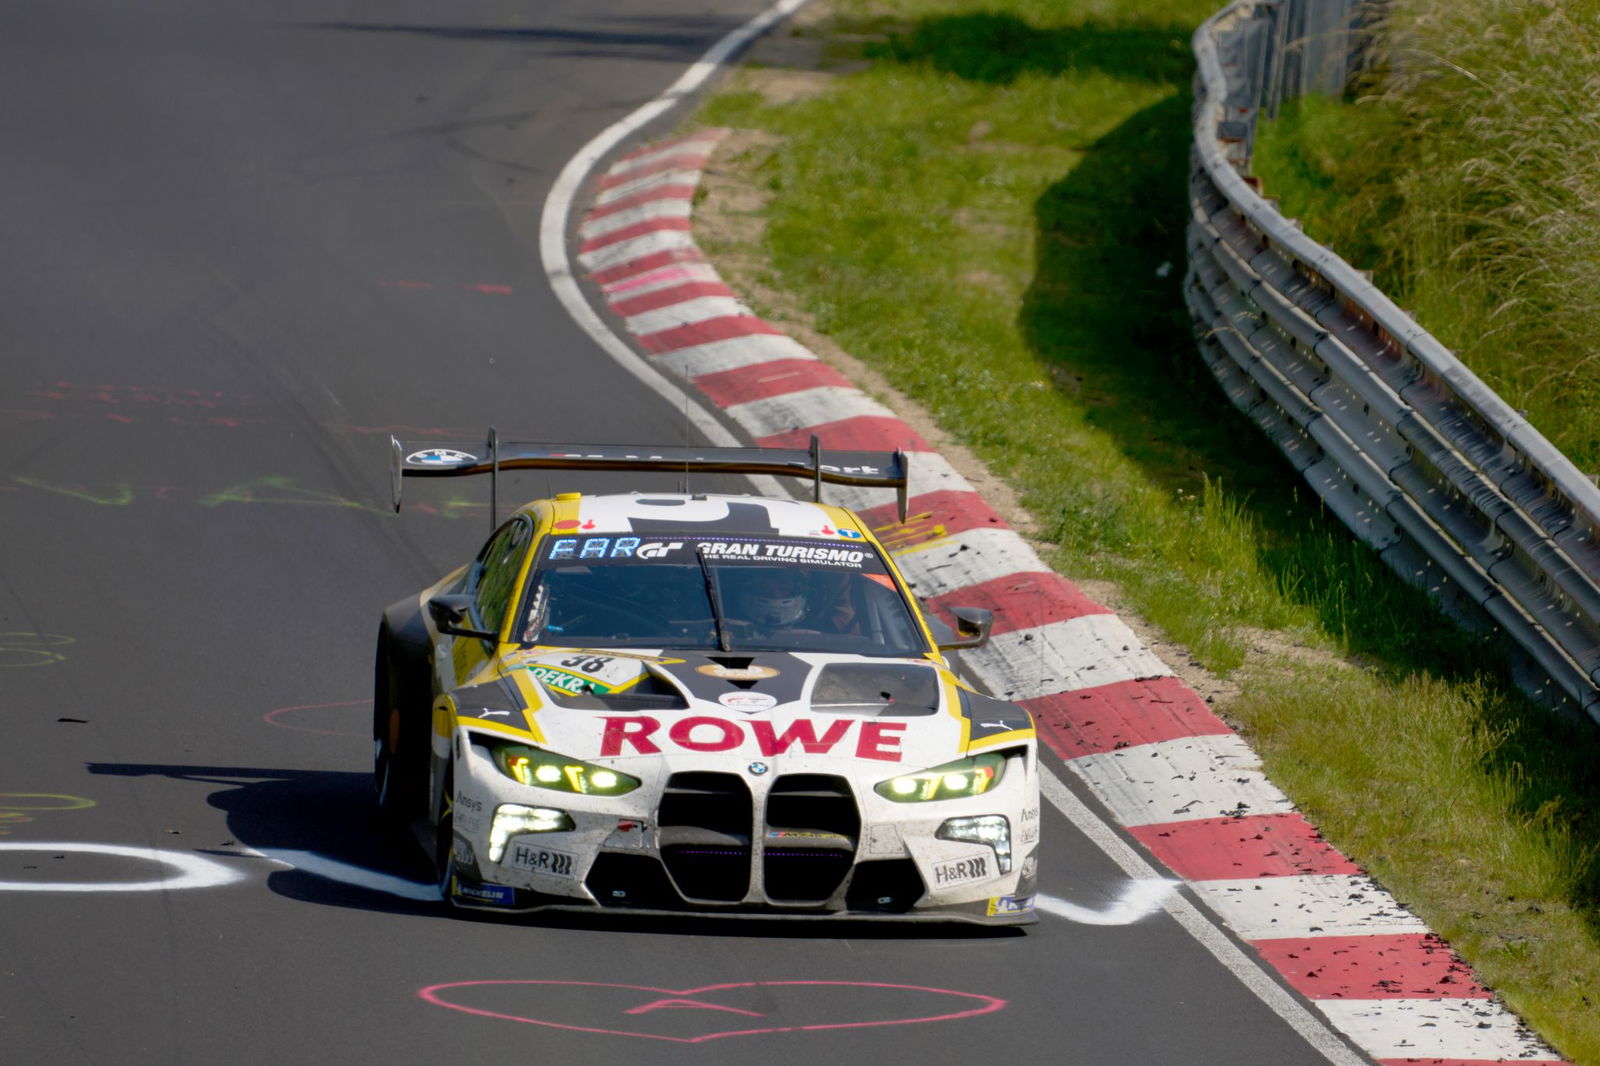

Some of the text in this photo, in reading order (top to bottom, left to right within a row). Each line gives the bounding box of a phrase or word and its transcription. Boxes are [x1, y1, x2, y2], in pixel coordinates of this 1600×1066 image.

[697, 542, 758, 556] GRAN
[752, 555, 798, 564] DRIVING
[800, 558, 863, 569] SIMULATOR
[592, 715, 908, 763] ROWE
[515, 845, 550, 870] H&R
[935, 861, 967, 884] H&R
